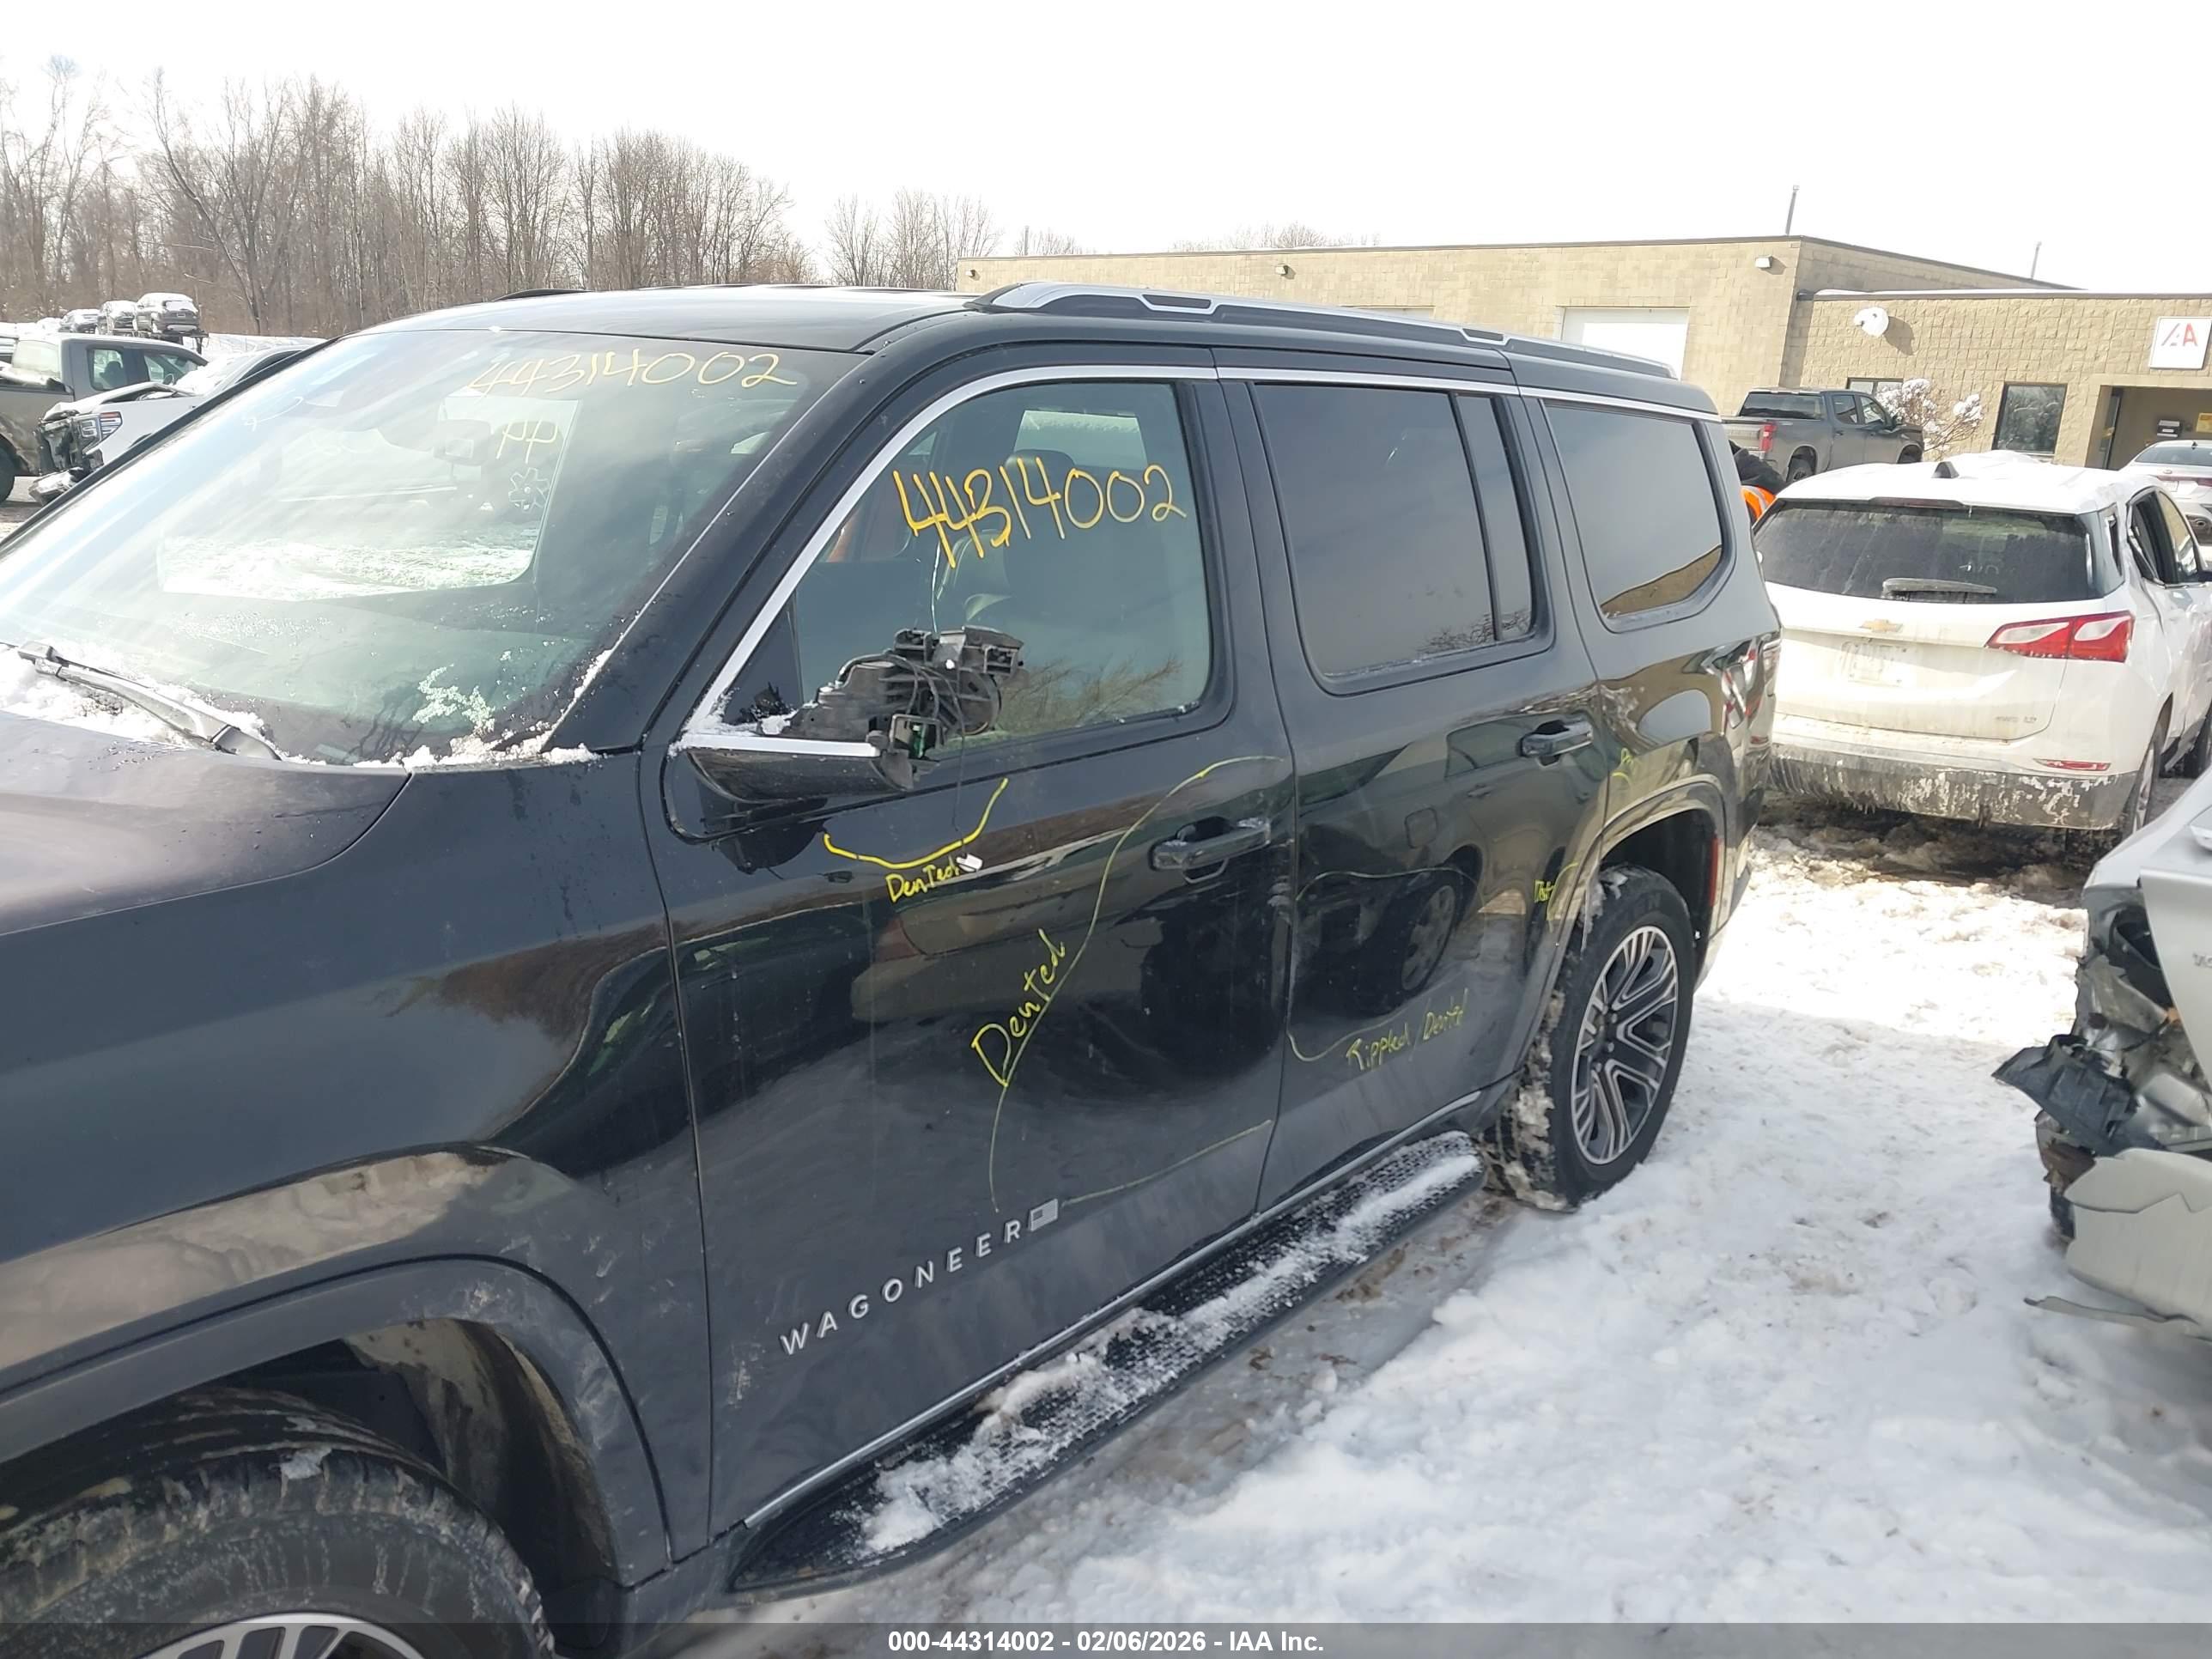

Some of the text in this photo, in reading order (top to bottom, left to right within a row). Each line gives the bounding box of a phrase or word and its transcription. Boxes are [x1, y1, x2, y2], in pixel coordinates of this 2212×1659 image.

[466, 348, 798, 396] 44314002
[892, 456, 1188, 569] 44314002
[779, 1218, 1022, 1357] WAGONEER
